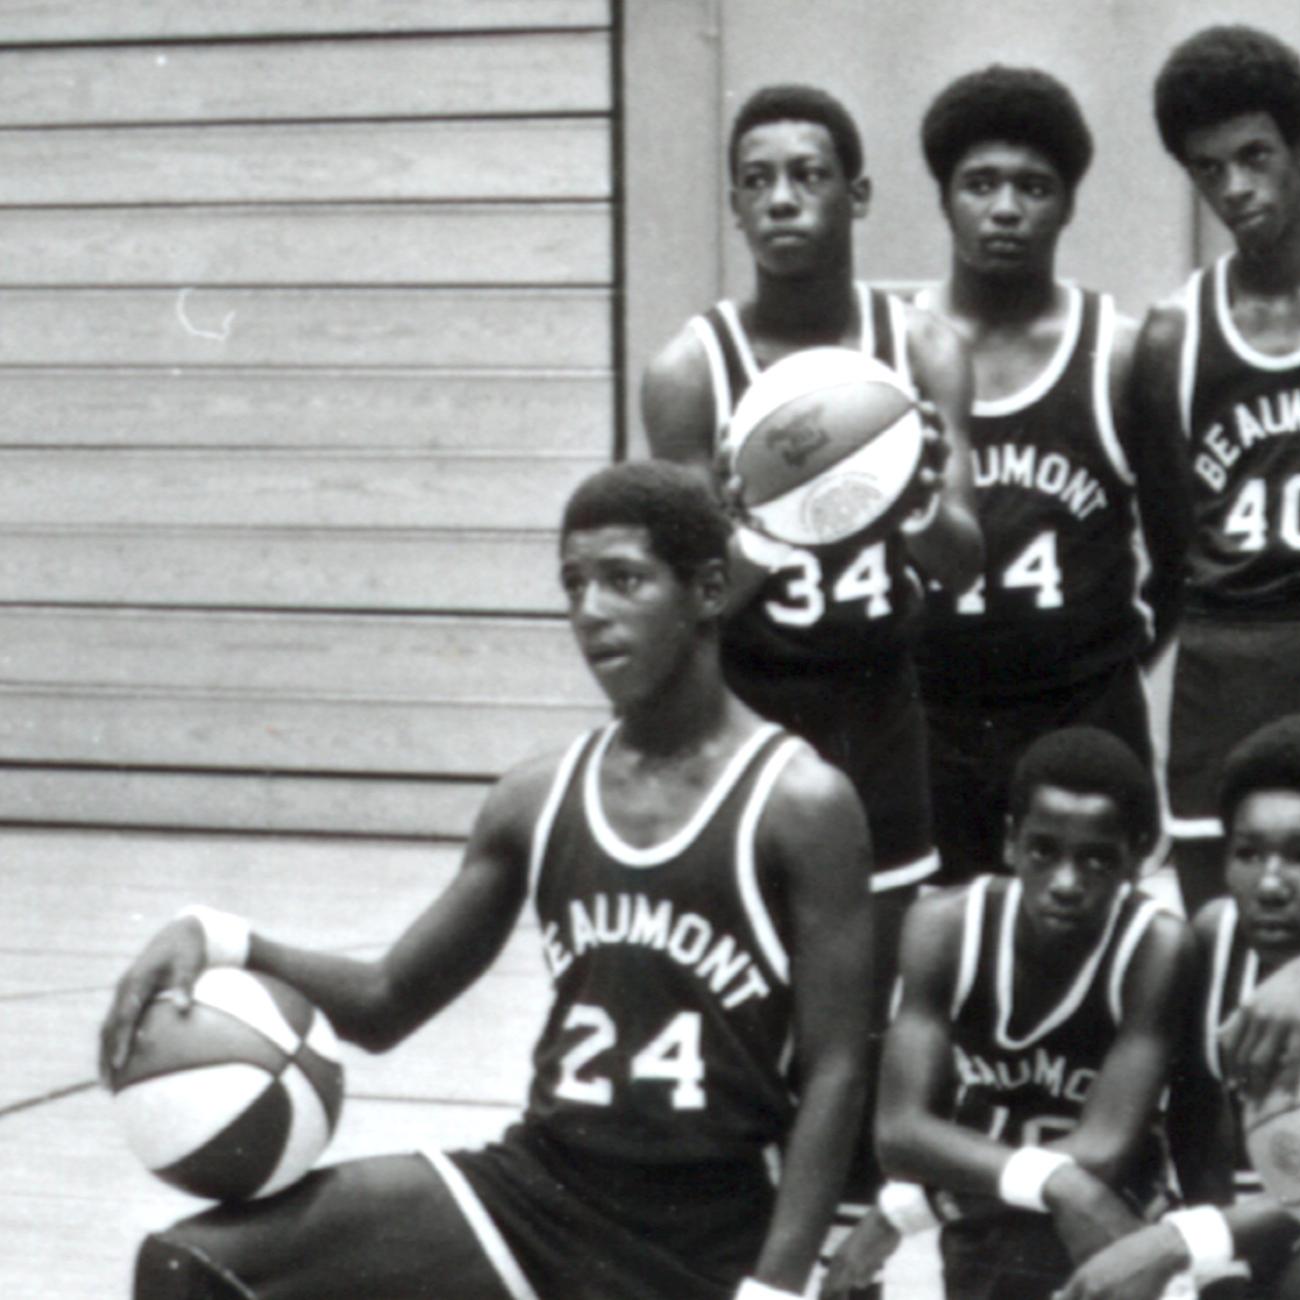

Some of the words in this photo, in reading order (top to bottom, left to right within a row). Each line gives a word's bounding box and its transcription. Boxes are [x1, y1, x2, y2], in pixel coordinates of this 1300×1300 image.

[971, 443, 1108, 521] UMONT
[764, 542, 892, 628] 34
[544, 893, 770, 1010] EAUMONT
[554, 1003, 706, 1110] 24
[953, 1044, 1098, 1106] AUMO
